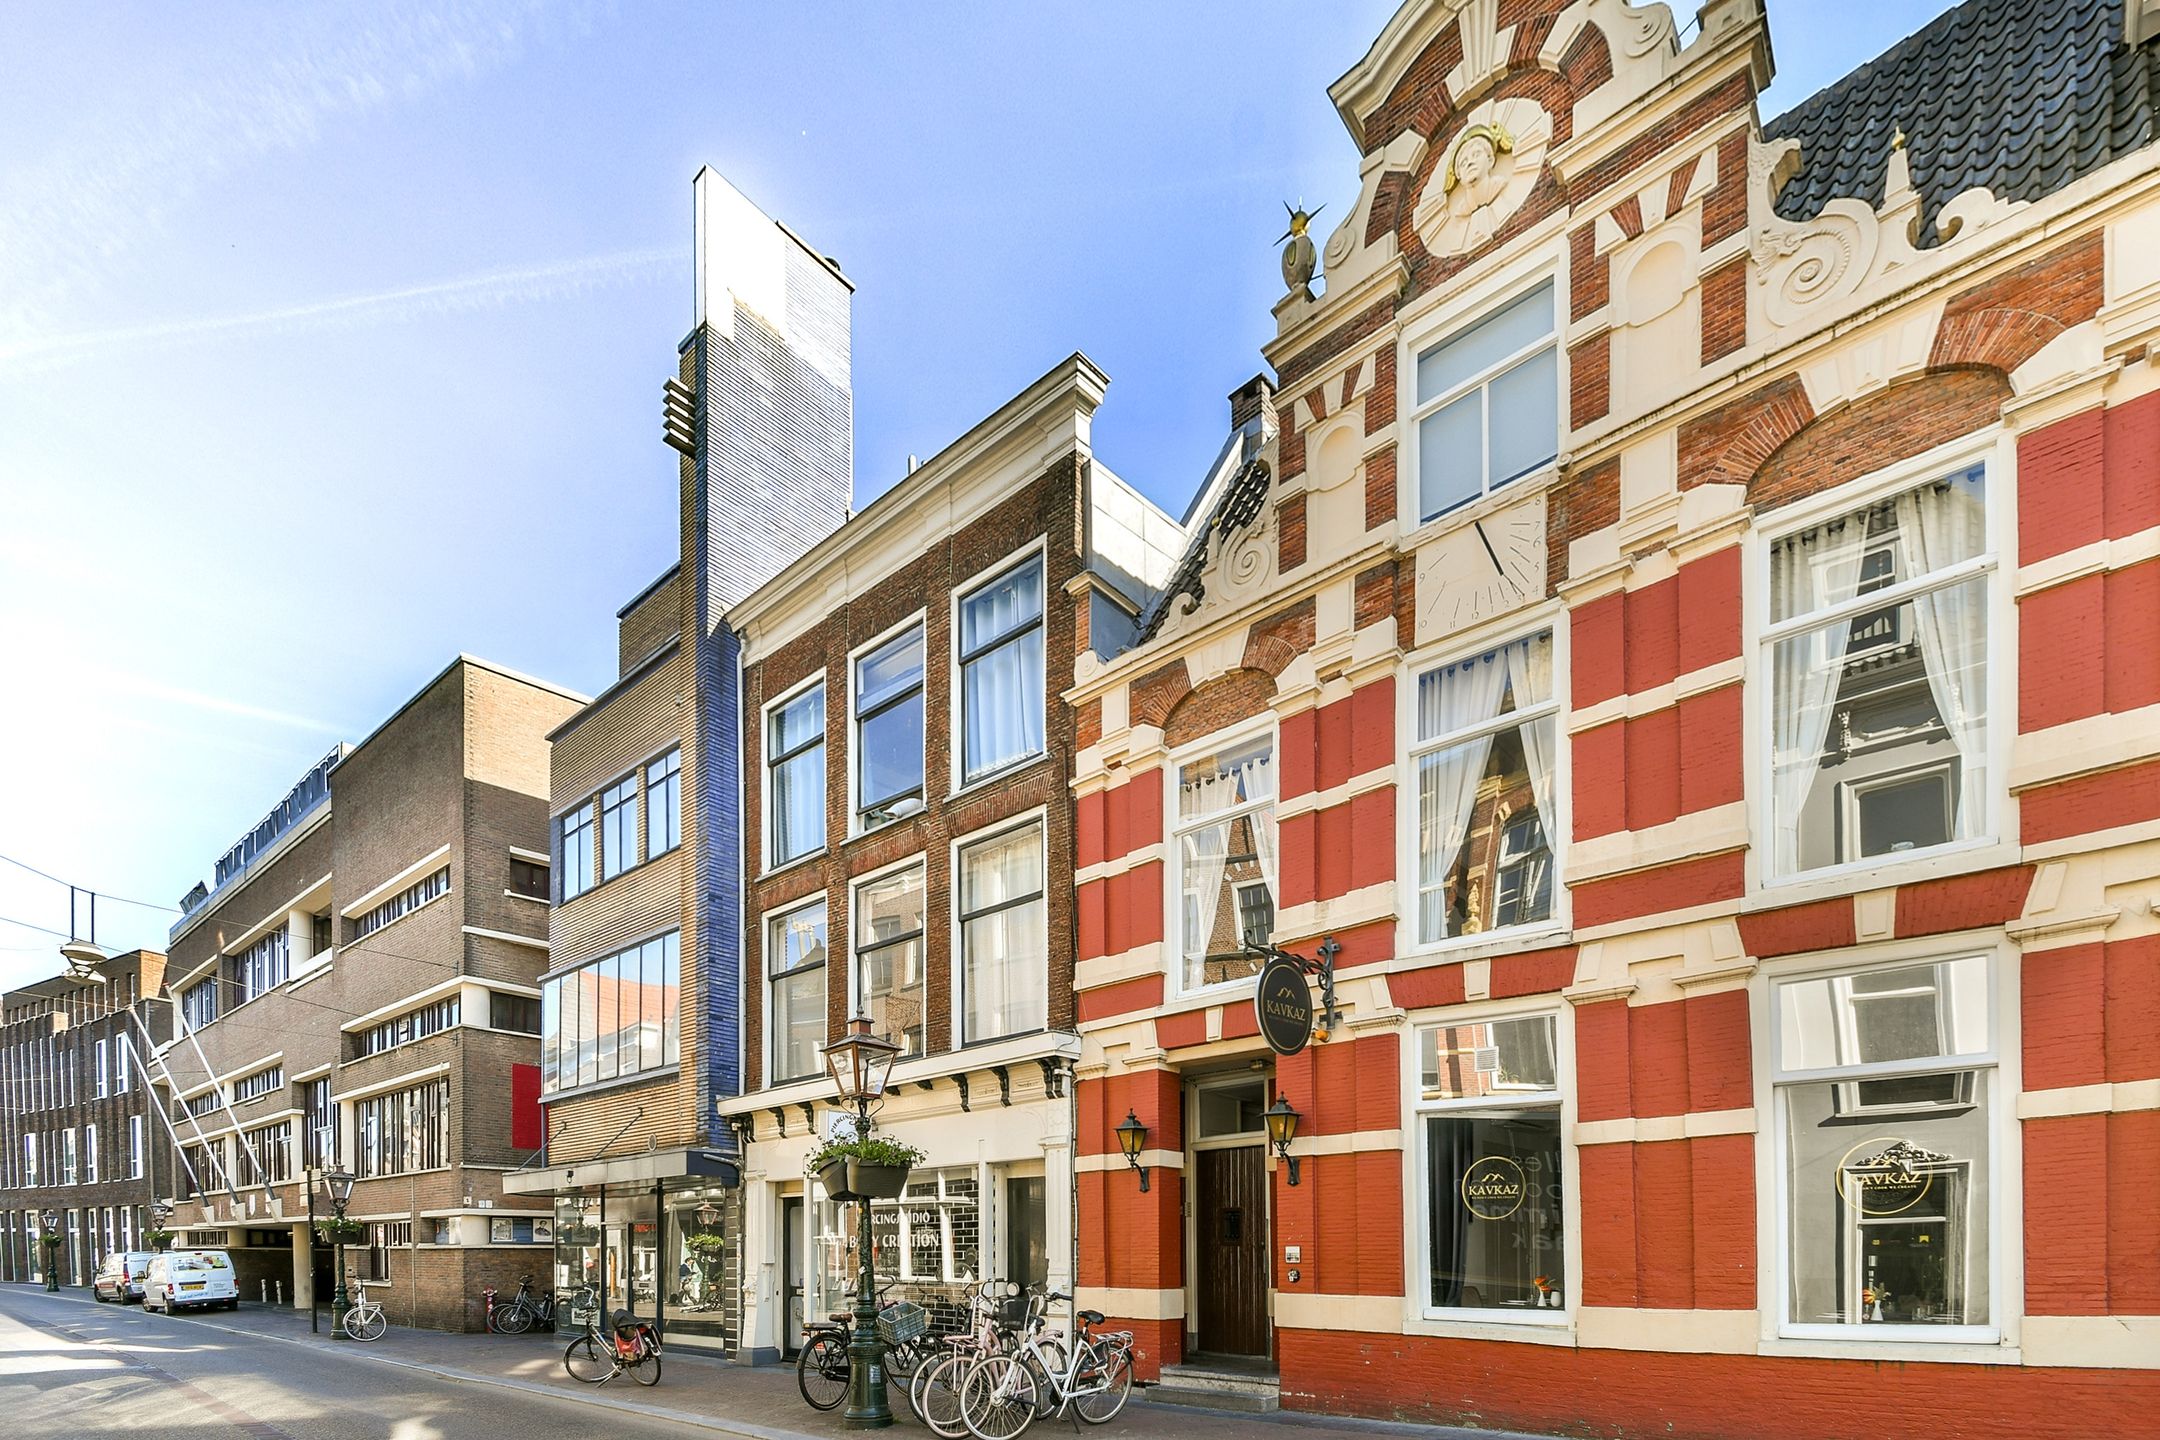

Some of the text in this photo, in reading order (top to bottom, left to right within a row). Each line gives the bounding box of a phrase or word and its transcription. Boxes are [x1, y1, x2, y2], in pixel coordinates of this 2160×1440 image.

[1535, 496, 1541, 506] 8
[1535, 521, 1541, 531] 7
[1533, 535, 1542, 548] 6
[1534, 561, 1540, 572] 5
[1419, 572, 1426, 584] 9
[1471, 611, 1480, 620] 12
[1418, 620, 1428, 629] 10
[1449, 620, 1456, 629] 11
[1266, 1000, 1306, 1021] KAVKAZ
[1850, 1171, 1922, 1185] KAVKAZ
[1469, 1184, 1519, 1196] KAVKAZ
[849, 1234, 939, 1248] BY CRTION
